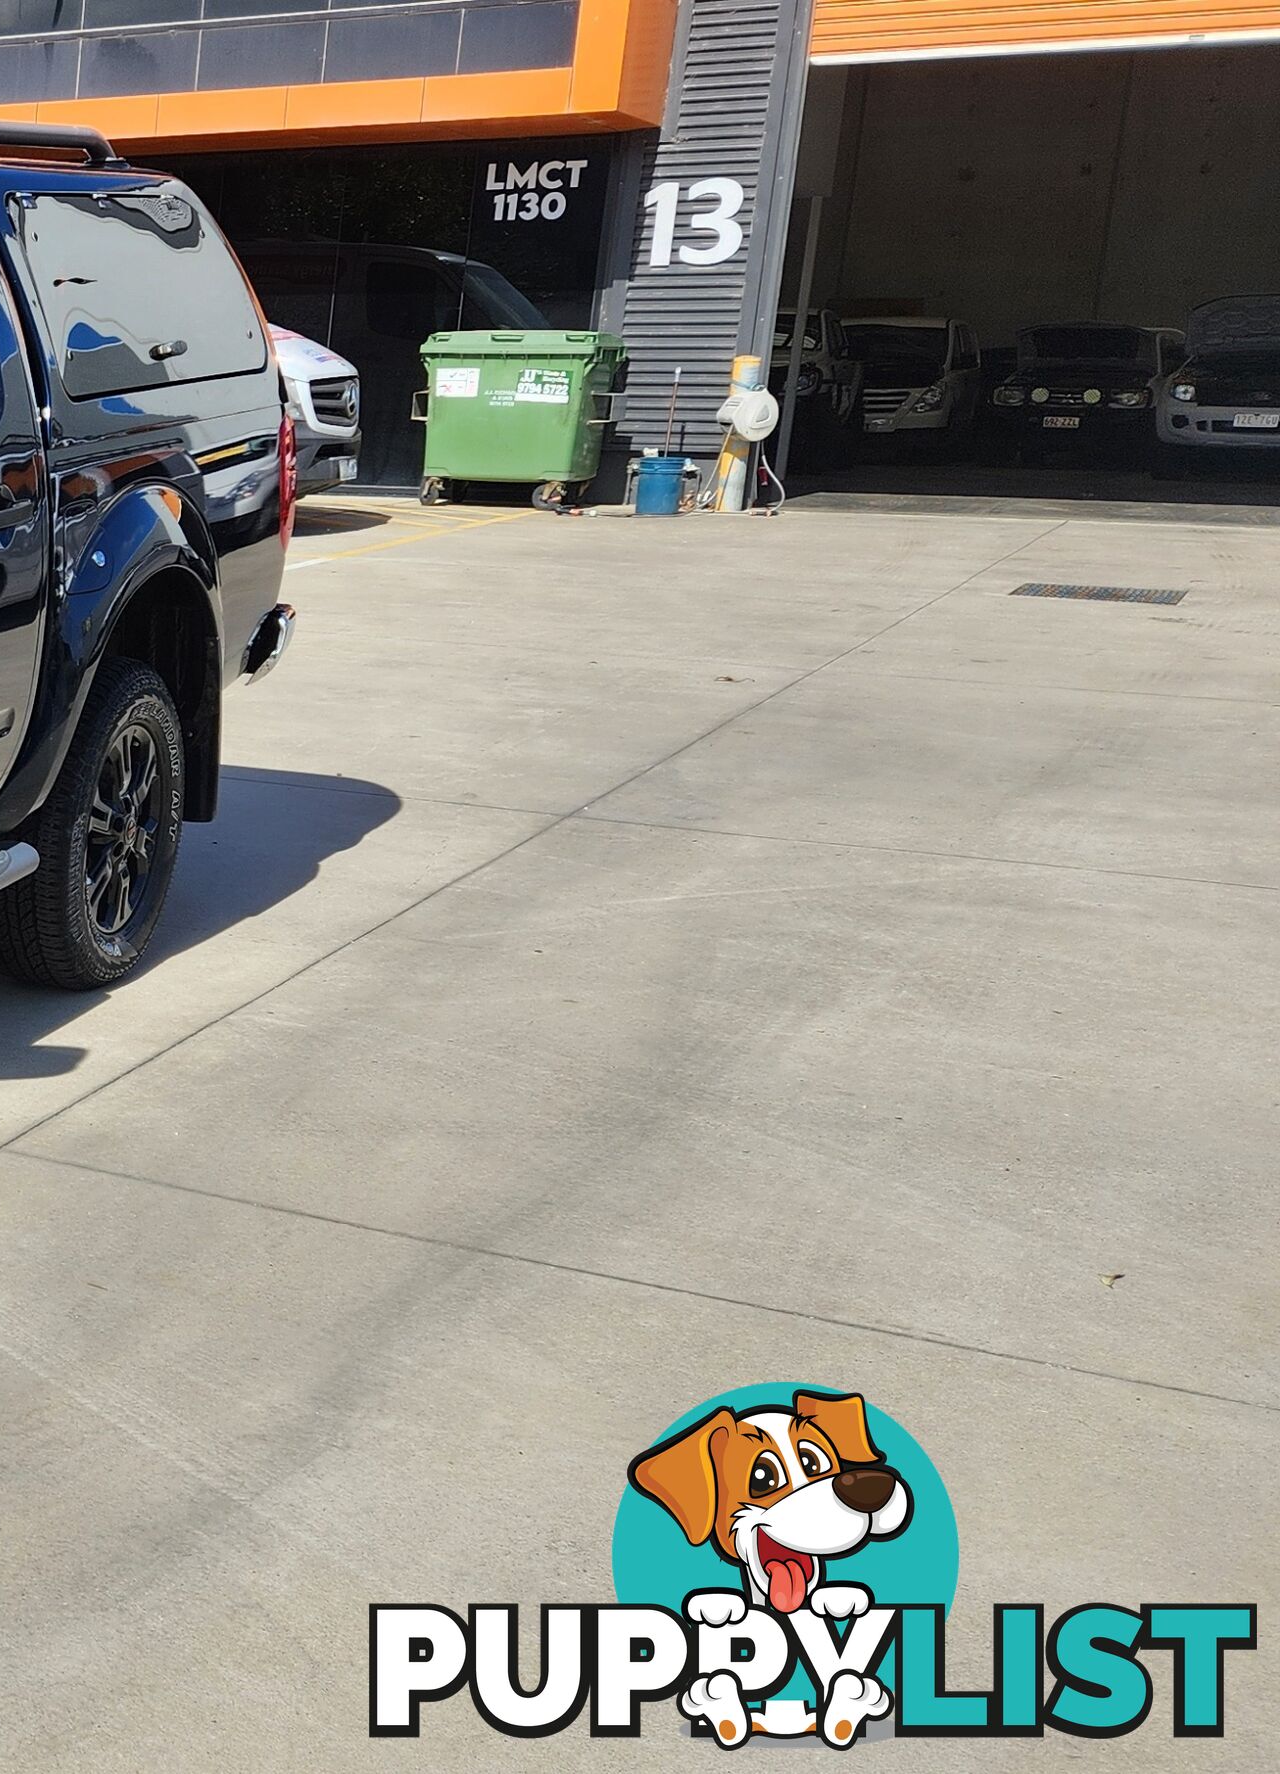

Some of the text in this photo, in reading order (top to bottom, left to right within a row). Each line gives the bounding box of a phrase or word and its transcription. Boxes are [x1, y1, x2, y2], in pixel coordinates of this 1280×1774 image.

[485, 160, 588, 191] LMCT
[493, 191, 567, 221] 1130
[643, 177, 744, 268] 13
[517, 382, 543, 395] 9794
